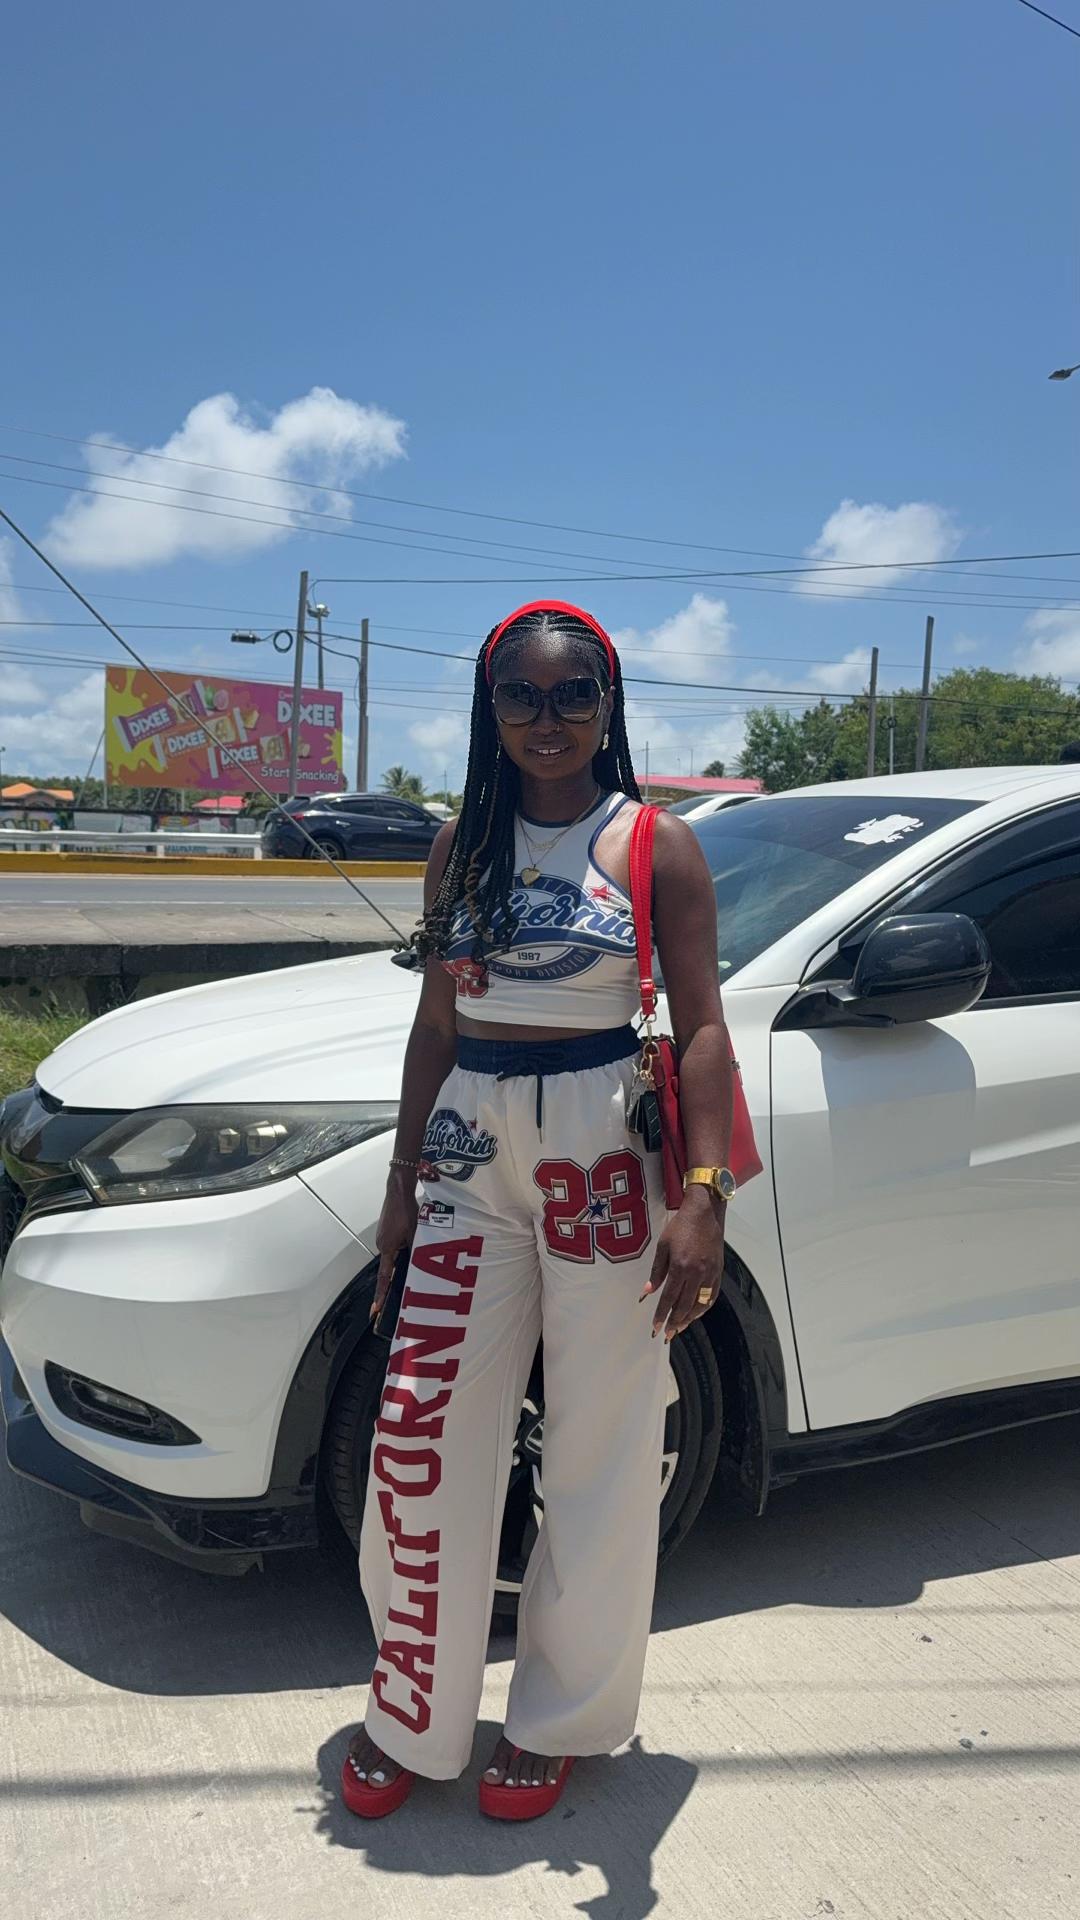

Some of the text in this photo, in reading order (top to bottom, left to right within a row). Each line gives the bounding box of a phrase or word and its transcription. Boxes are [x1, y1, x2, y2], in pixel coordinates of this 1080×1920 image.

[128, 708, 170, 737] DIXEE
[278, 700, 335, 727] DXEE
[167, 729, 206, 752] DIXEE
[261, 766, 339, 784] Start Snacking
[517, 952, 541, 961] 1987
[536, 948, 593, 977] DIVISION
[422, 1119, 498, 1160] alifornia
[533, 1148, 651, 1264] 23
[373, 1235, 484, 1735] CALIFORNIA
